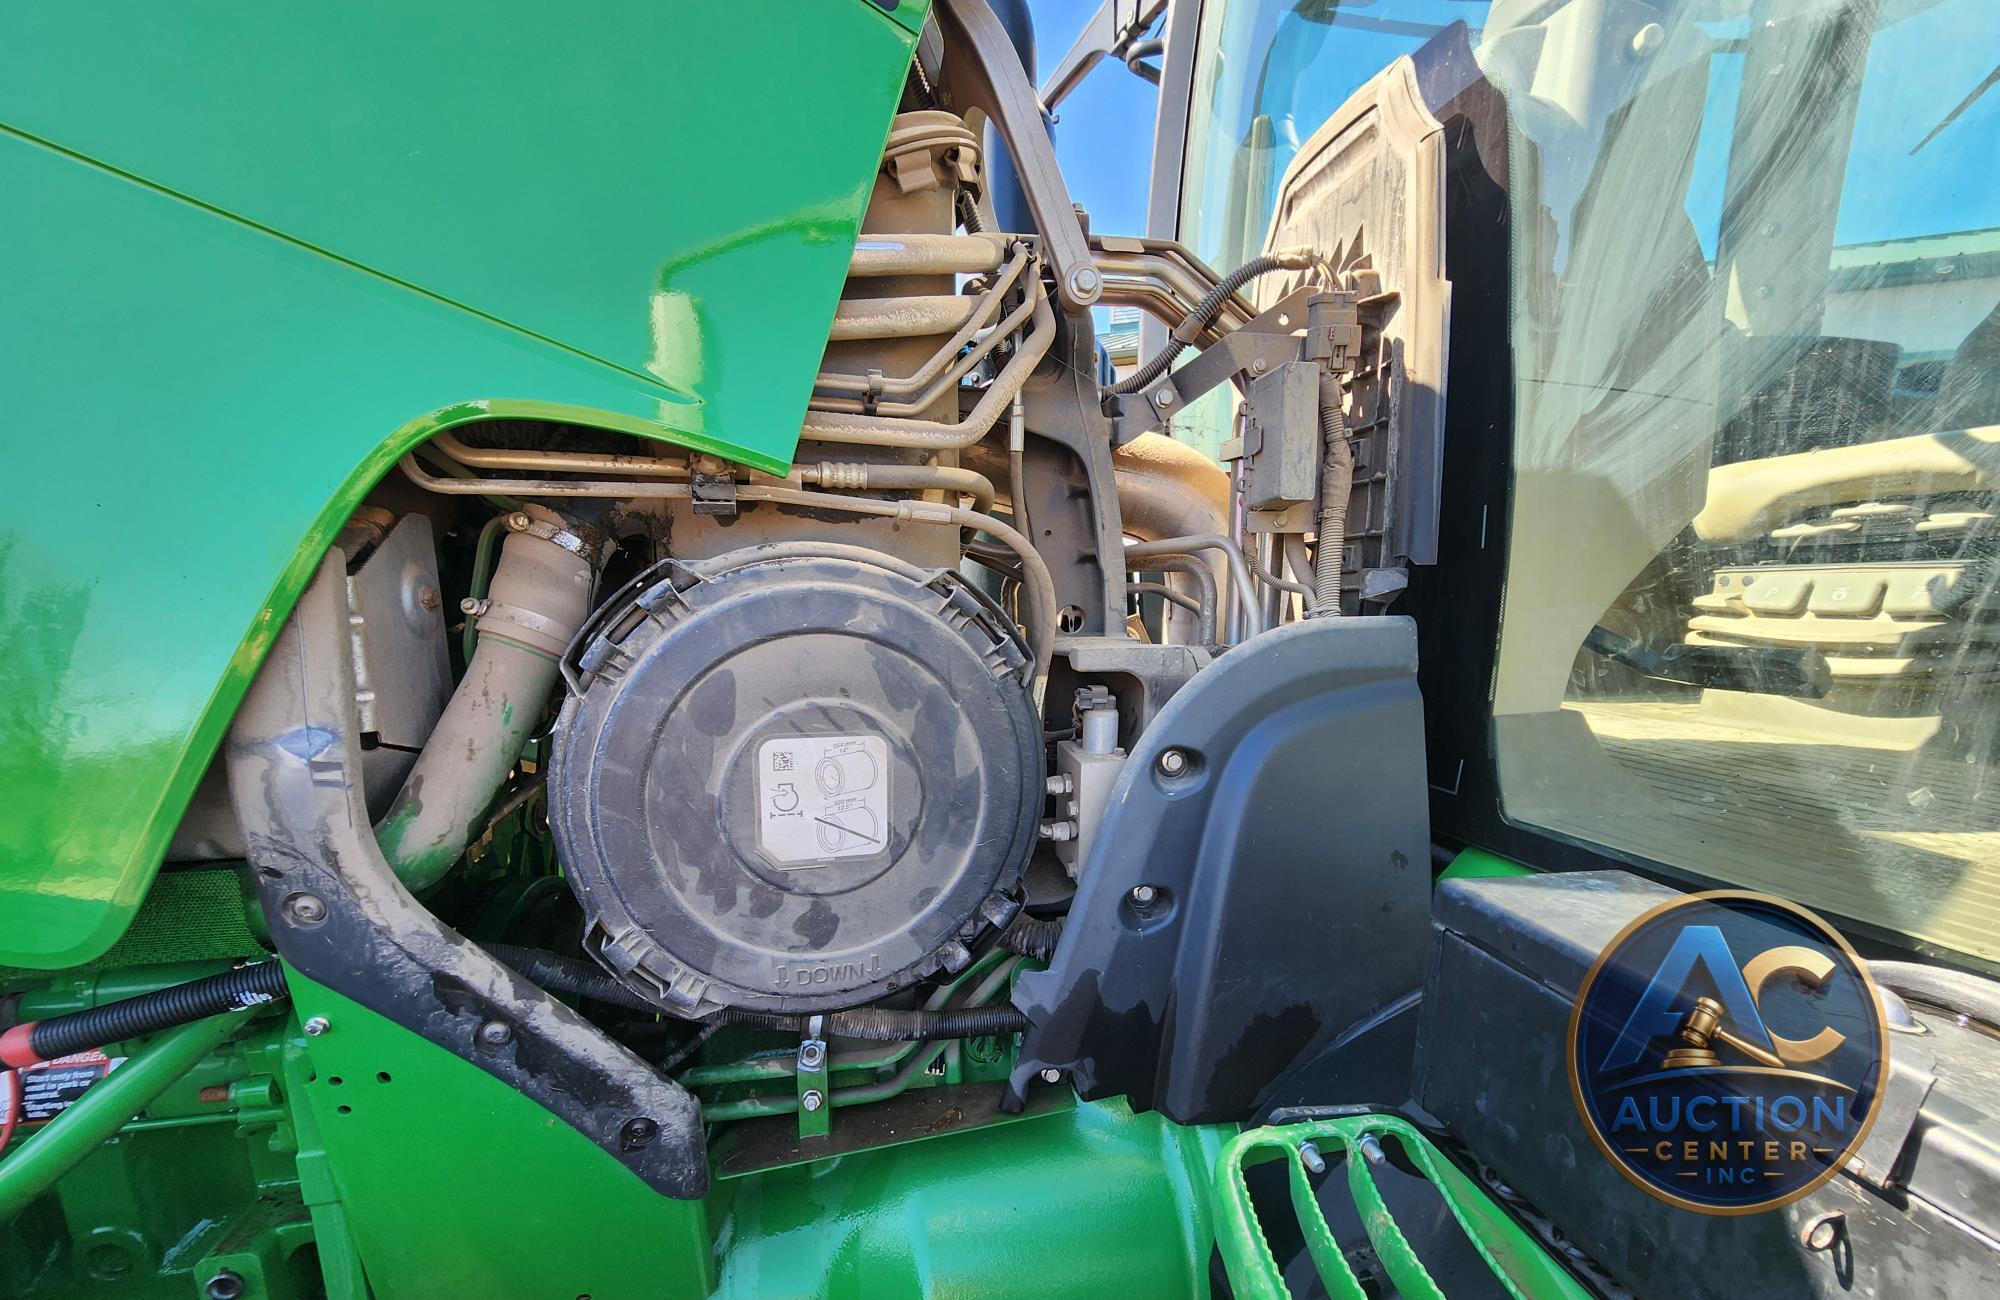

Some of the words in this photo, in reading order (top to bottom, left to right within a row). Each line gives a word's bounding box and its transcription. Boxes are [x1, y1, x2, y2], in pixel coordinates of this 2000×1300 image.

[796, 961, 865, 986] DOWN
[26, 1074, 50, 1083] Start
[51, 1072, 72, 1082] only
[72, 1070, 94, 1080] from
[24, 1083, 46, 1092] seat
[57, 1081, 79, 1091] park
[24, 1091, 60, 1101] neutral.
[24, 1102, 63, 1111] Starting
